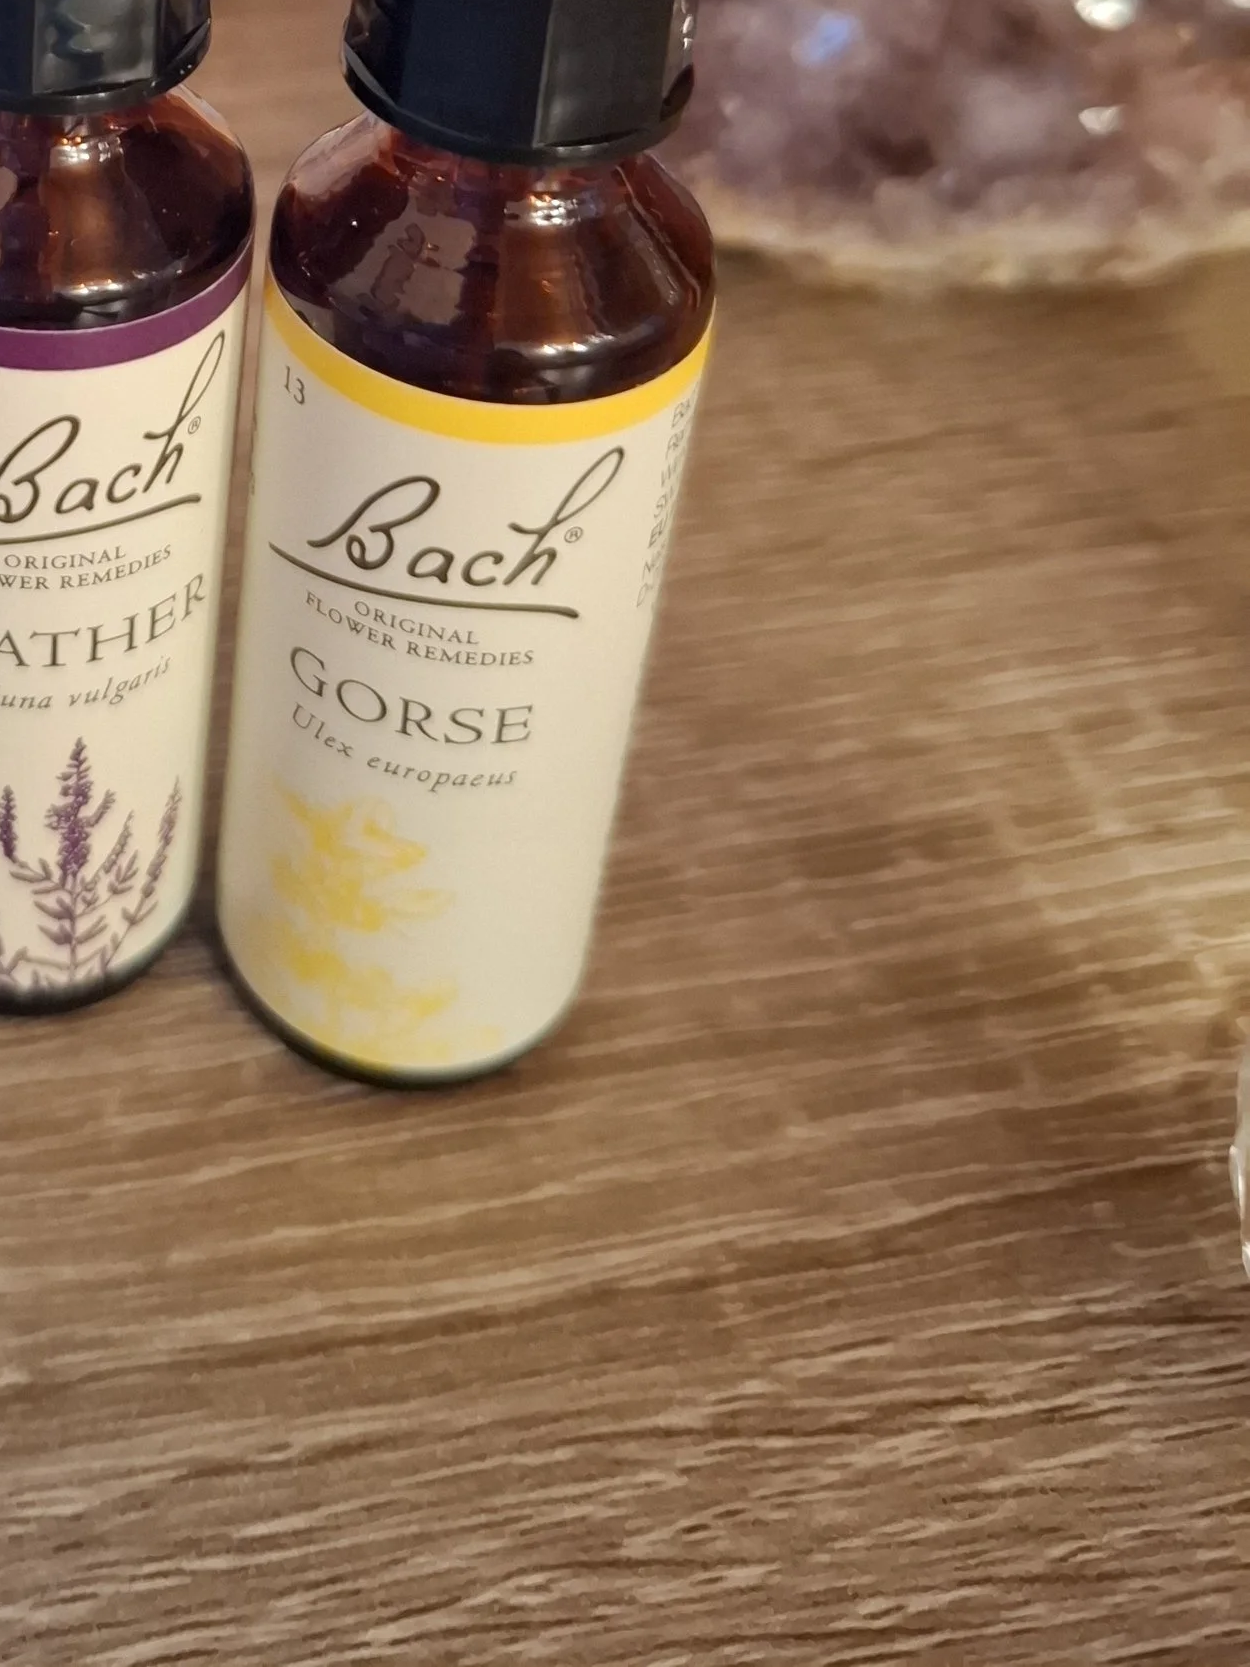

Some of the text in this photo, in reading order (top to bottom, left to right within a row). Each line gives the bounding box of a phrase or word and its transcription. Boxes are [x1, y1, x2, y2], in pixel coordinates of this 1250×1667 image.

[284, 365, 306, 405] 13
[4, 546, 127, 570] ORIGINAL
[60, 544, 172, 590] REMEDIES
[305, 591, 535, 666] FLOWER REMEDIES
[354, 601, 480, 646] ORIGINAL
[68, 655, 170, 706] vulgaris
[290, 646, 533, 745] GORSE
[292, 701, 518, 793] Ulex europaeus
